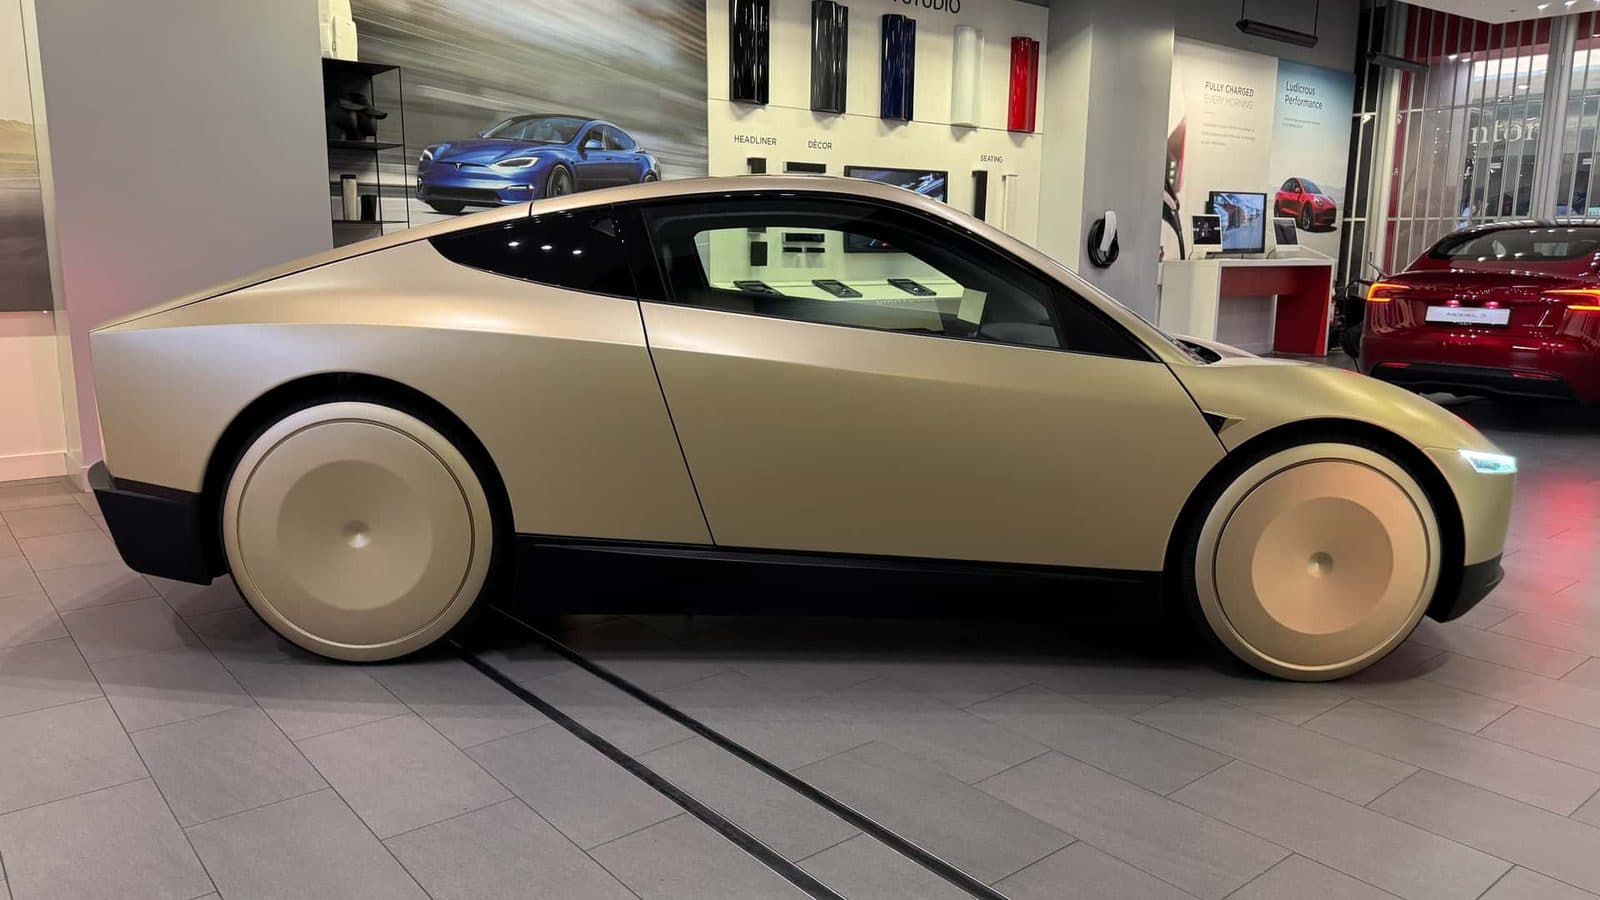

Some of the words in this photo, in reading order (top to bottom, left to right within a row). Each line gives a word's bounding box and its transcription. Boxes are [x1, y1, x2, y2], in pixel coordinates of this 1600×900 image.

[1205, 81, 1224, 92] FULLY
[1225, 84, 1254, 97] CHARGED
[1286, 81, 1315, 95] Ludicrous
[1284, 94, 1322, 109] Performance
[734, 135, 777, 145] HEADLINER
[807, 139, 832, 150] DÉCOR
[980, 154, 1003, 164] SEATING
